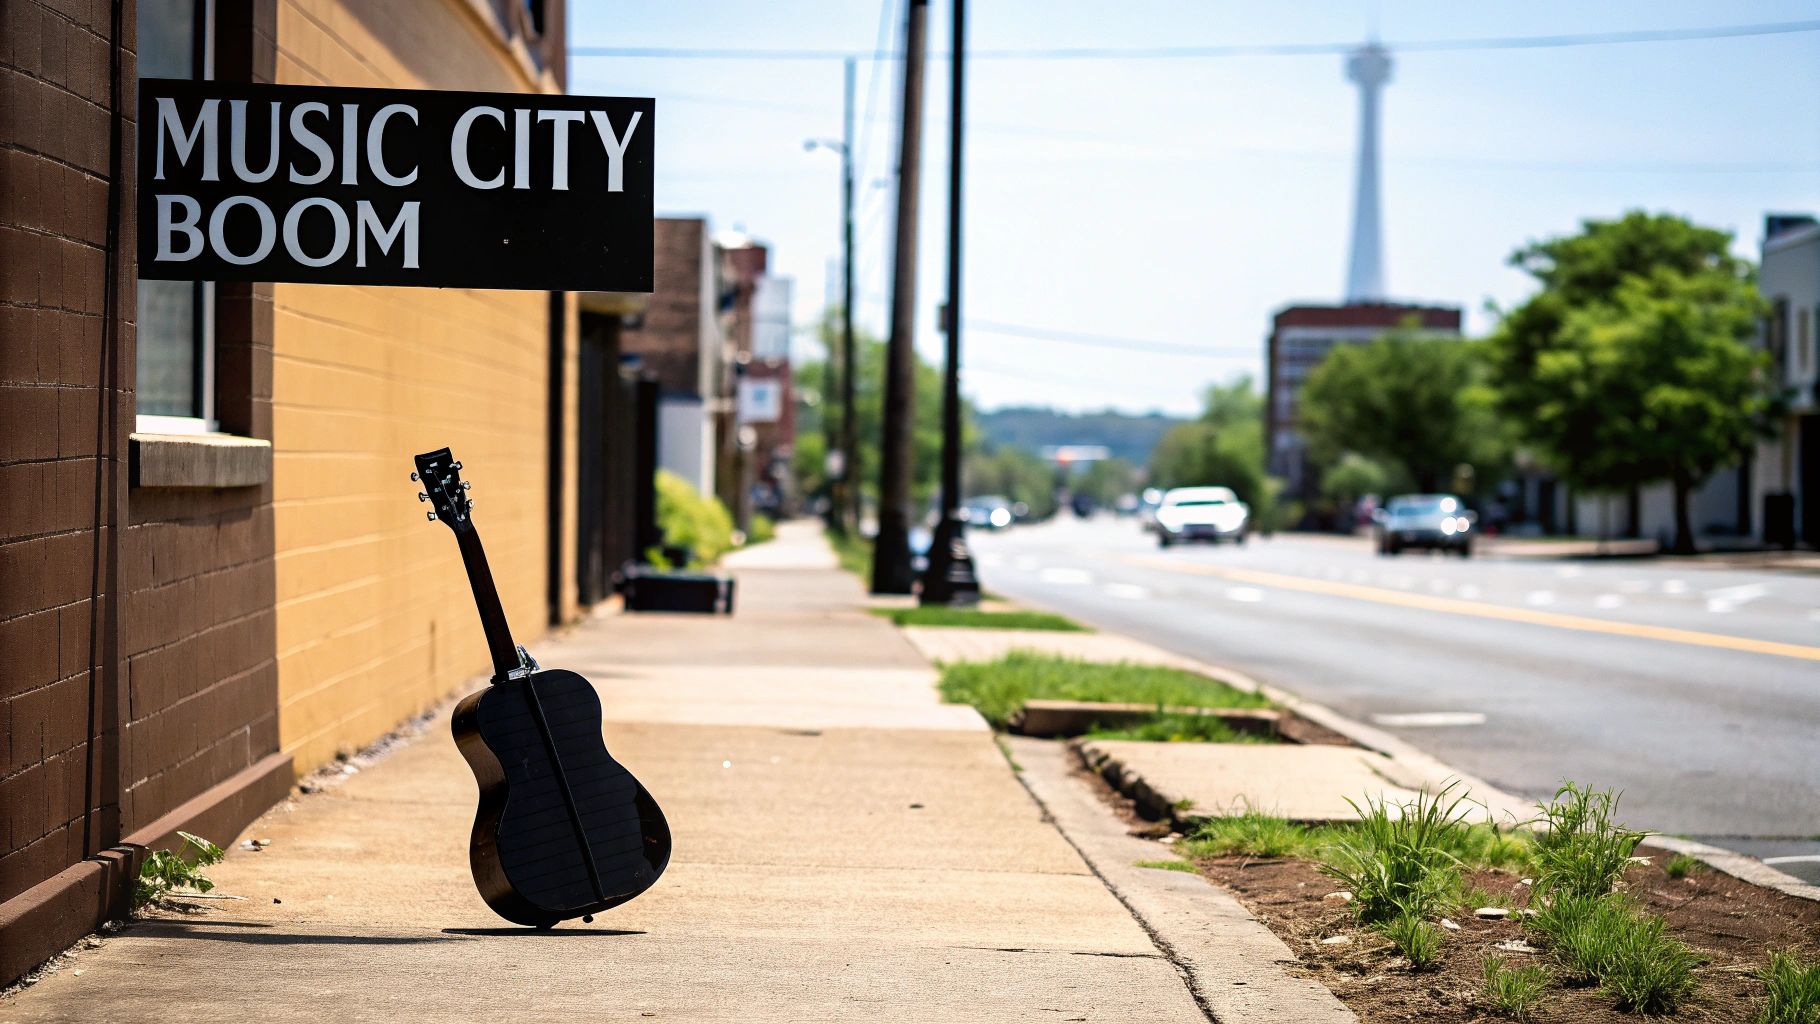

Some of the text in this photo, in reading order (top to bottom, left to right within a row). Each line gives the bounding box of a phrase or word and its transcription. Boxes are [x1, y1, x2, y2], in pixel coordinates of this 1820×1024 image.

[154, 97, 643, 192] MUSIC CITY
[154, 194, 421, 269] BOOM
